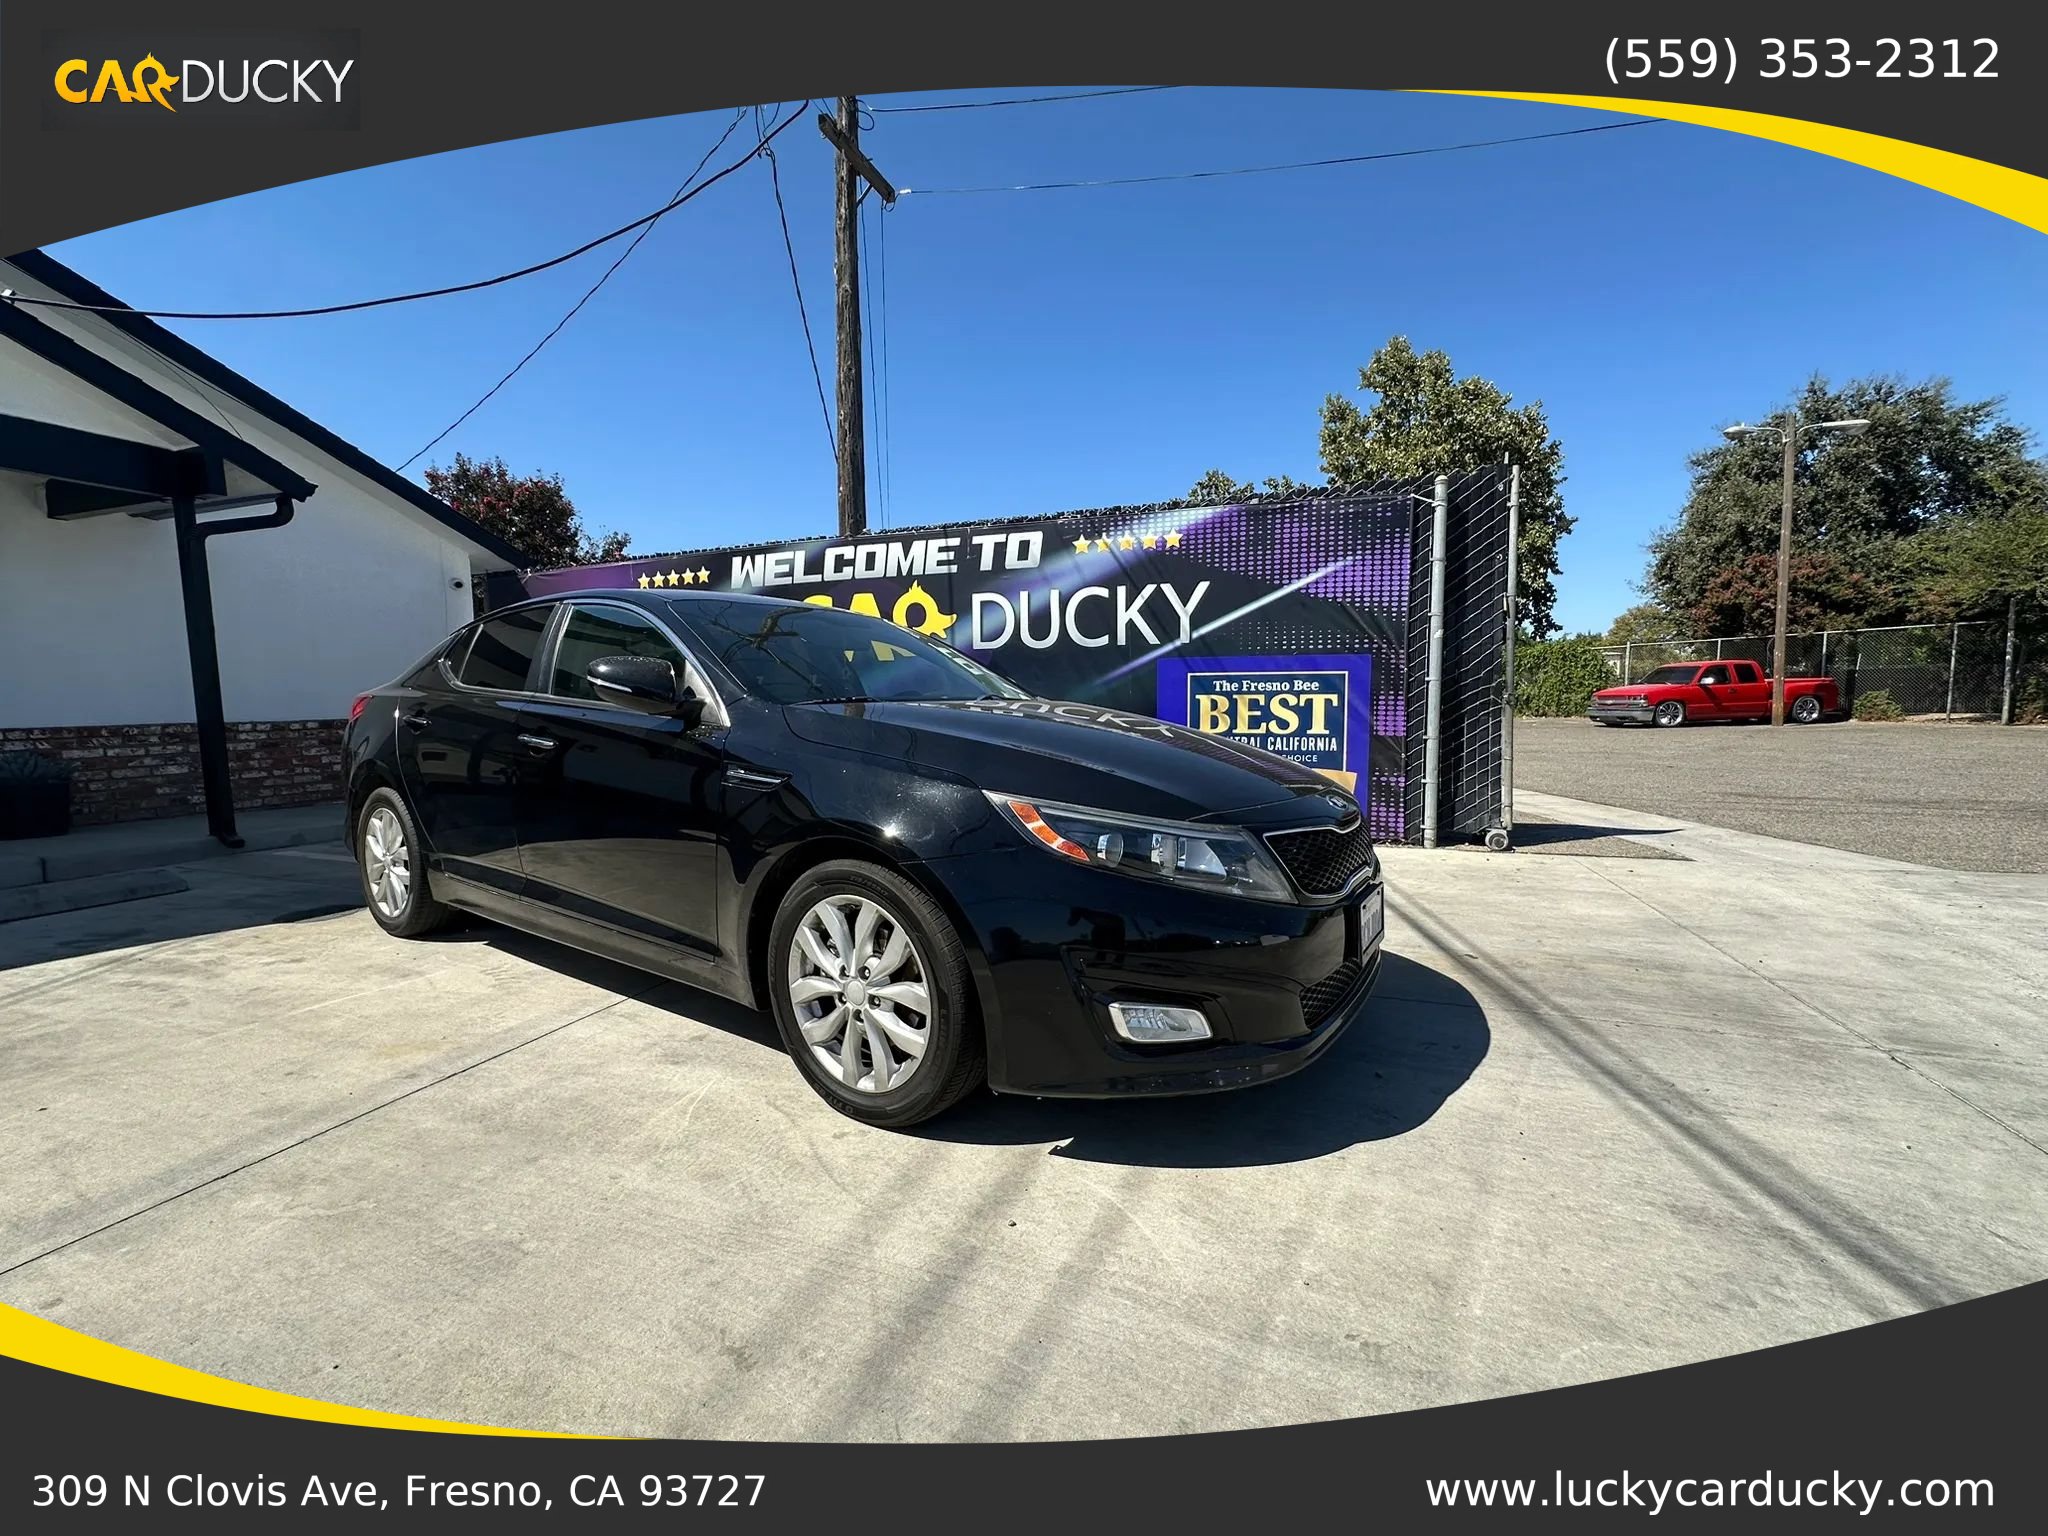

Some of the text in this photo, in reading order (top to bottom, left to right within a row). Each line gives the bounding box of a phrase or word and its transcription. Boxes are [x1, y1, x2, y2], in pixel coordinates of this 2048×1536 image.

[731, 531, 1044, 588] WELCOME TO
[971, 581, 1211, 650] DUCKY
[1213, 680, 1320, 691] The Fresno Bee
[1195, 693, 1338, 735] BEST
[1267, 736, 1338, 751] CALIFORNIA
